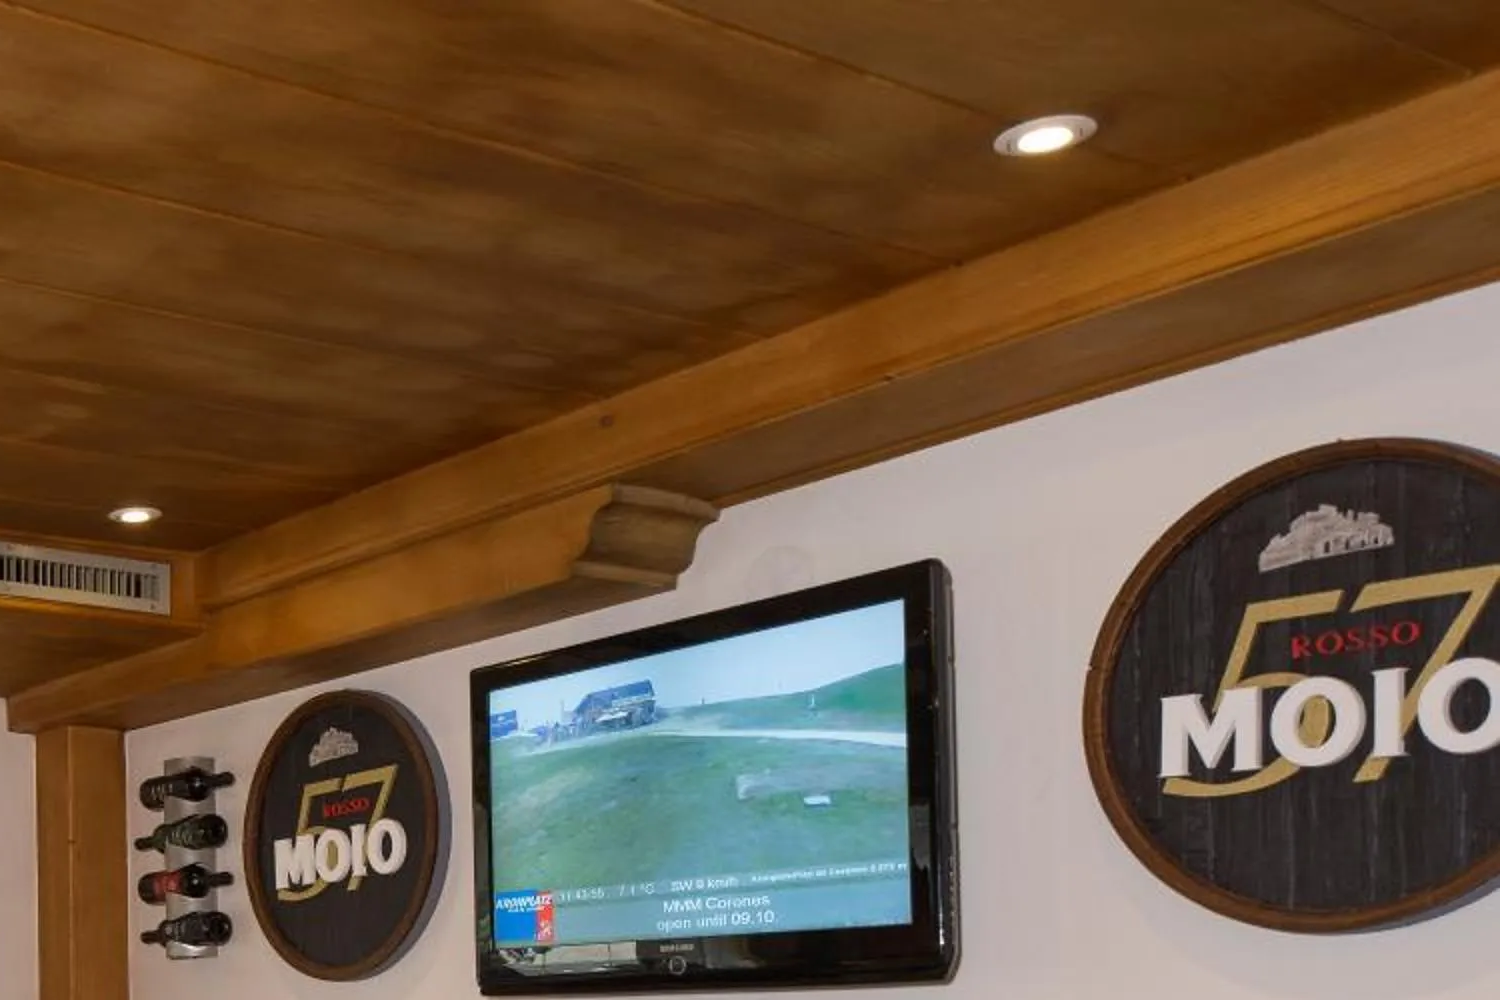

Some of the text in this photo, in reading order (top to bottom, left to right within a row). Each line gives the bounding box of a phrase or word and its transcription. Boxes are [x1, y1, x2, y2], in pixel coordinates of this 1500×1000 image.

[1291, 620, 1421, 660] ROSSO
[1158, 657, 1500, 779] MOIO
[273, 818, 407, 890] MOIO
